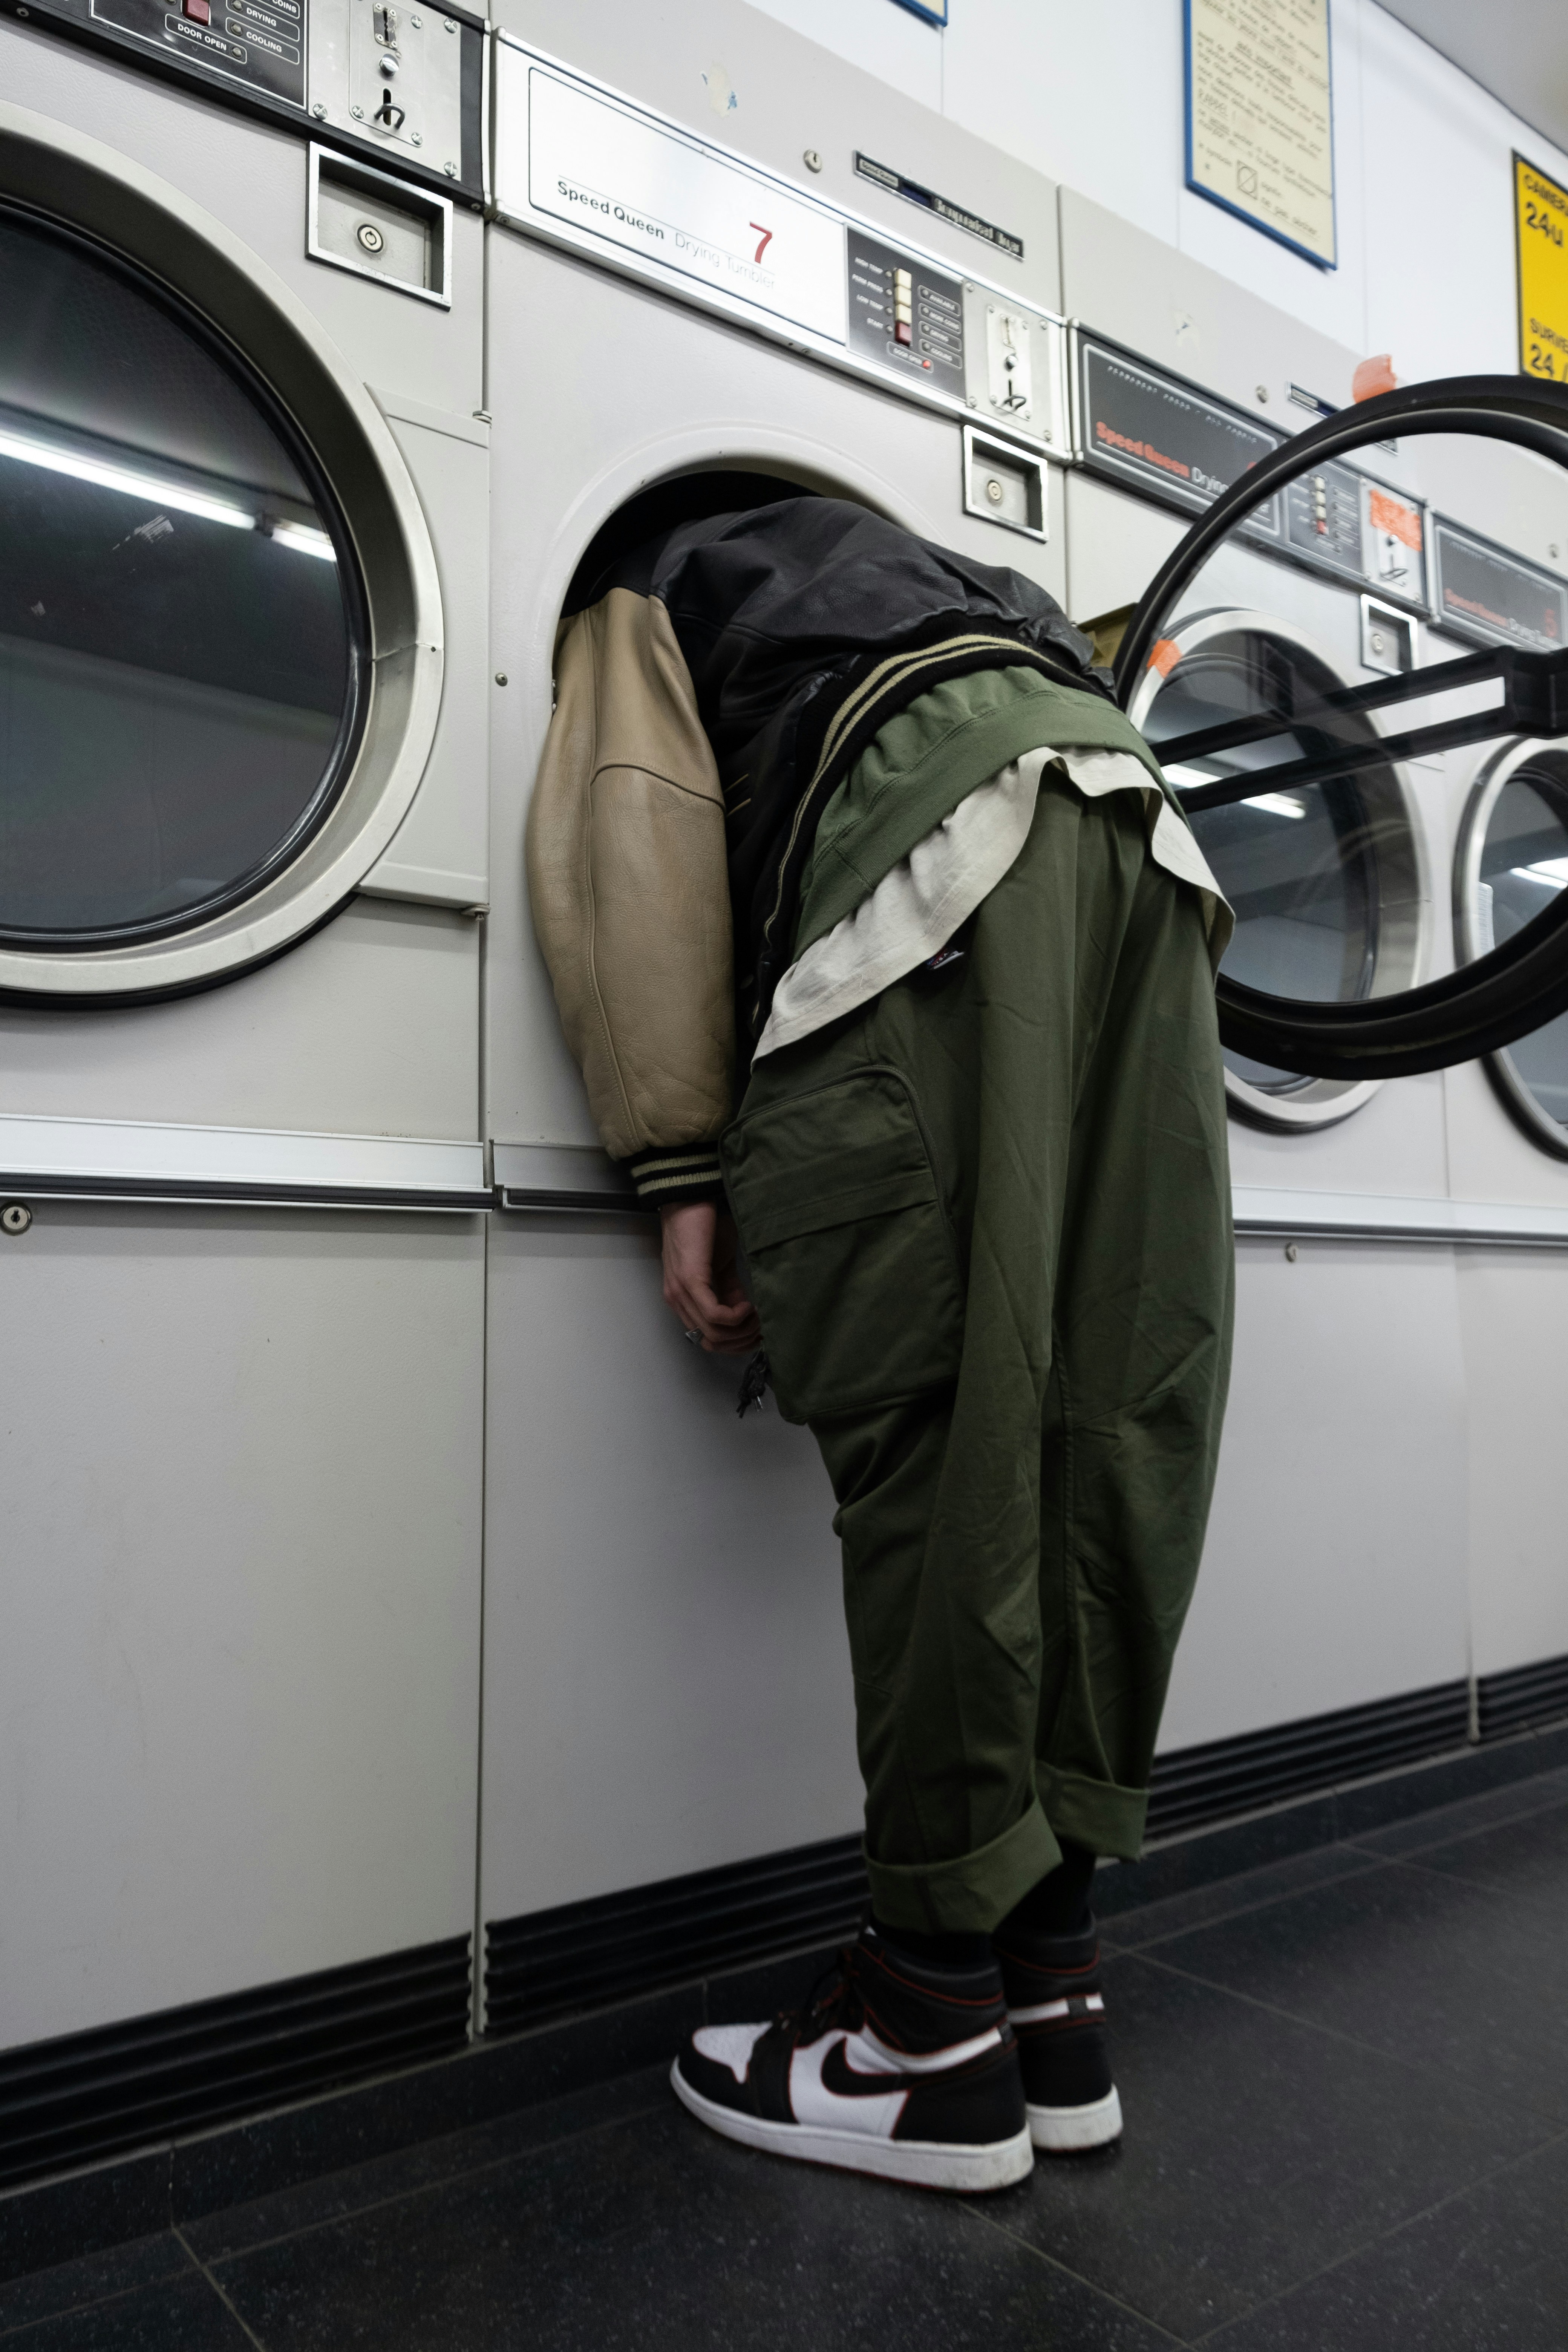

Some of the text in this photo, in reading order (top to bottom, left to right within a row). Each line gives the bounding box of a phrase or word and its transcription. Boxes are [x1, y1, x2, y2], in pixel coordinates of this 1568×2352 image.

[246, 7, 277, 26] DRYING
[178, 23, 227, 51] DOOR OPEN
[246, 31, 282, 53] COOLING
[1524, 174, 1568, 217] CAMER
[557, 181, 775, 289] Speed Queen Drying Tumbler
[749, 221, 772, 264] 7
[1096, 421, 1144, 456] Speed
